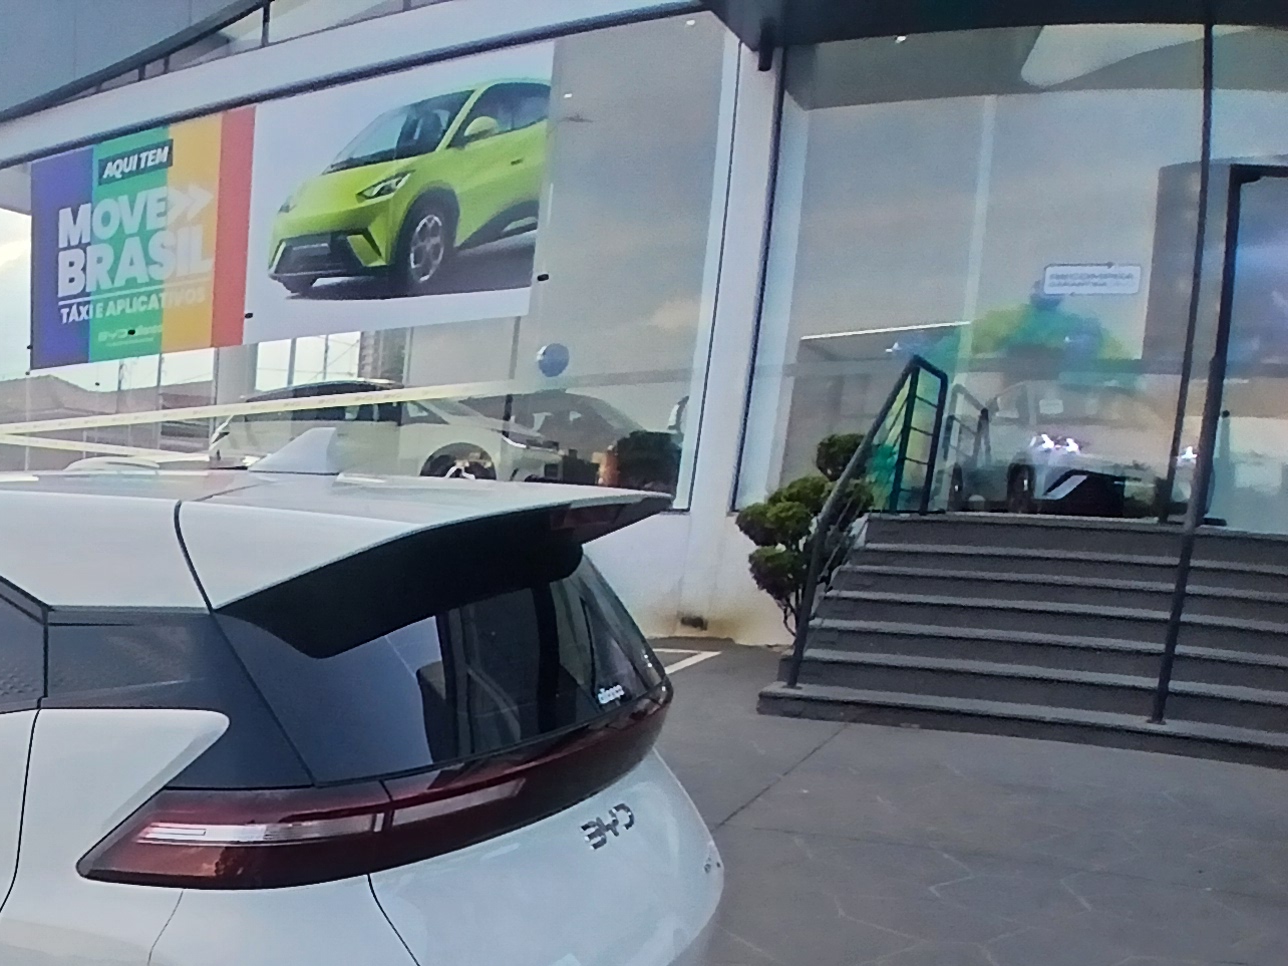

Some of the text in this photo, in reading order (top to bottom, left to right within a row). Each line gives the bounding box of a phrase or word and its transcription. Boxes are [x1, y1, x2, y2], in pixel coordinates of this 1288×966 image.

[103, 145, 170, 180] AQUI TEM
[58, 186, 169, 249] MOVE
[57, 224, 214, 298] BRASIL
[95, 302, 104, 319] E
[104, 285, 206, 318] APLICATIVOS
[579, 802, 635, 850] BYD
